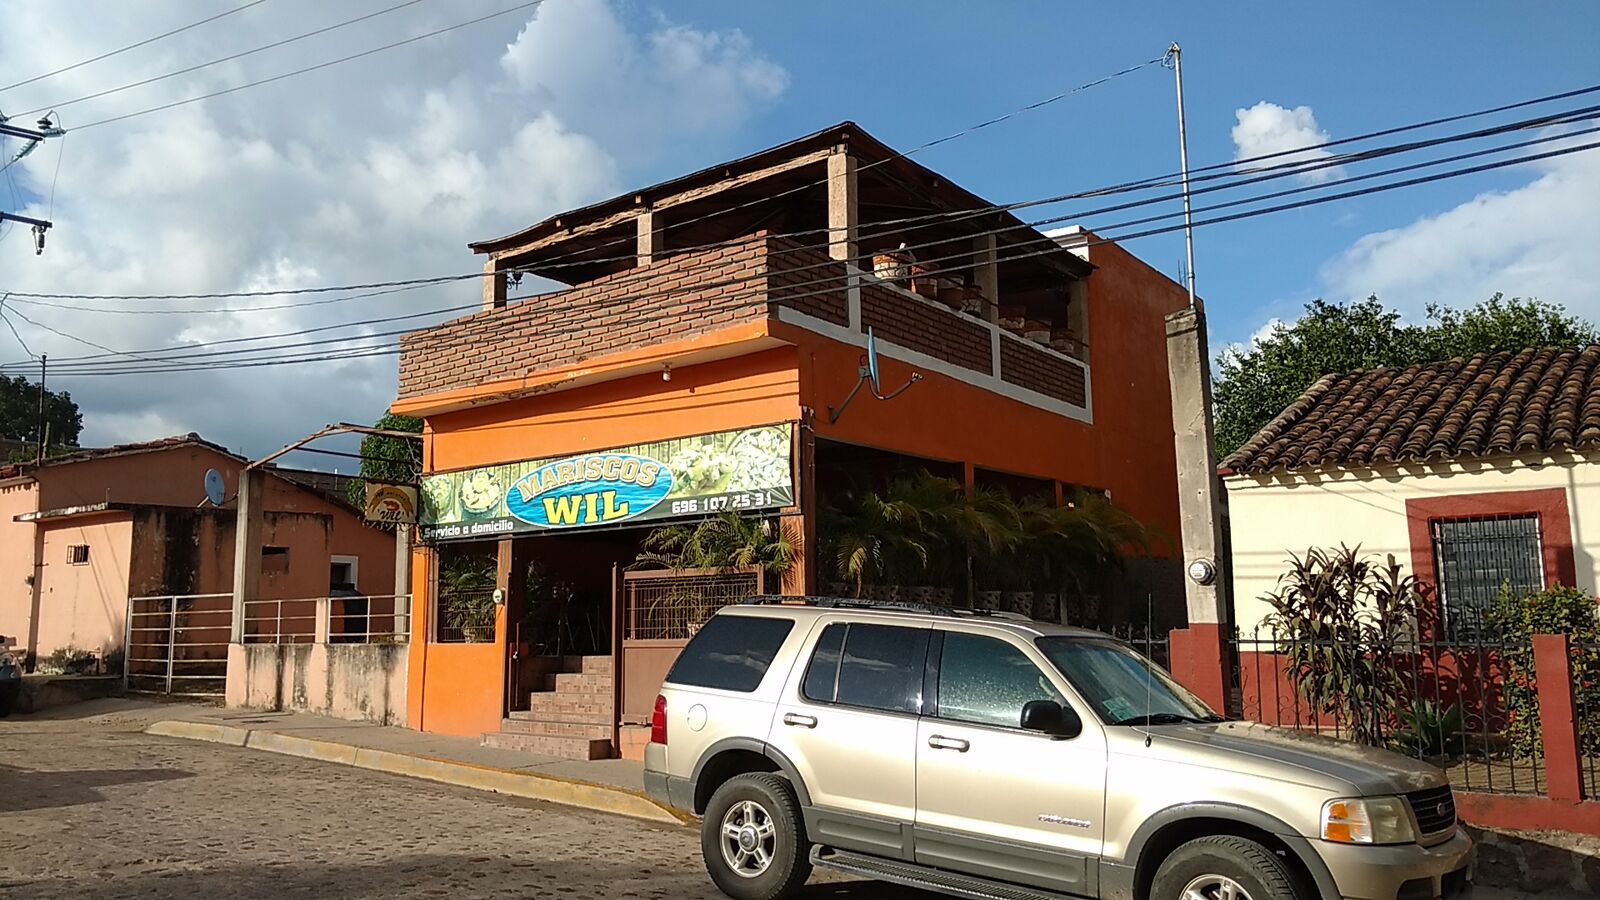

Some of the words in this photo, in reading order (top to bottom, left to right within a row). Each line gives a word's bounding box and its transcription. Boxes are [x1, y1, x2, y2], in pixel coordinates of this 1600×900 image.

[516, 456, 660, 502] MARISCOS
[542, 490, 630, 526] WIL
[671, 499, 698, 514] 696
[703, 496, 728, 511] 107
[755, 491, 772, 506] 31
[423, 524, 461, 539] Servicio
[463, 525, 469, 535] a
[471, 519, 514, 534] domicilio
